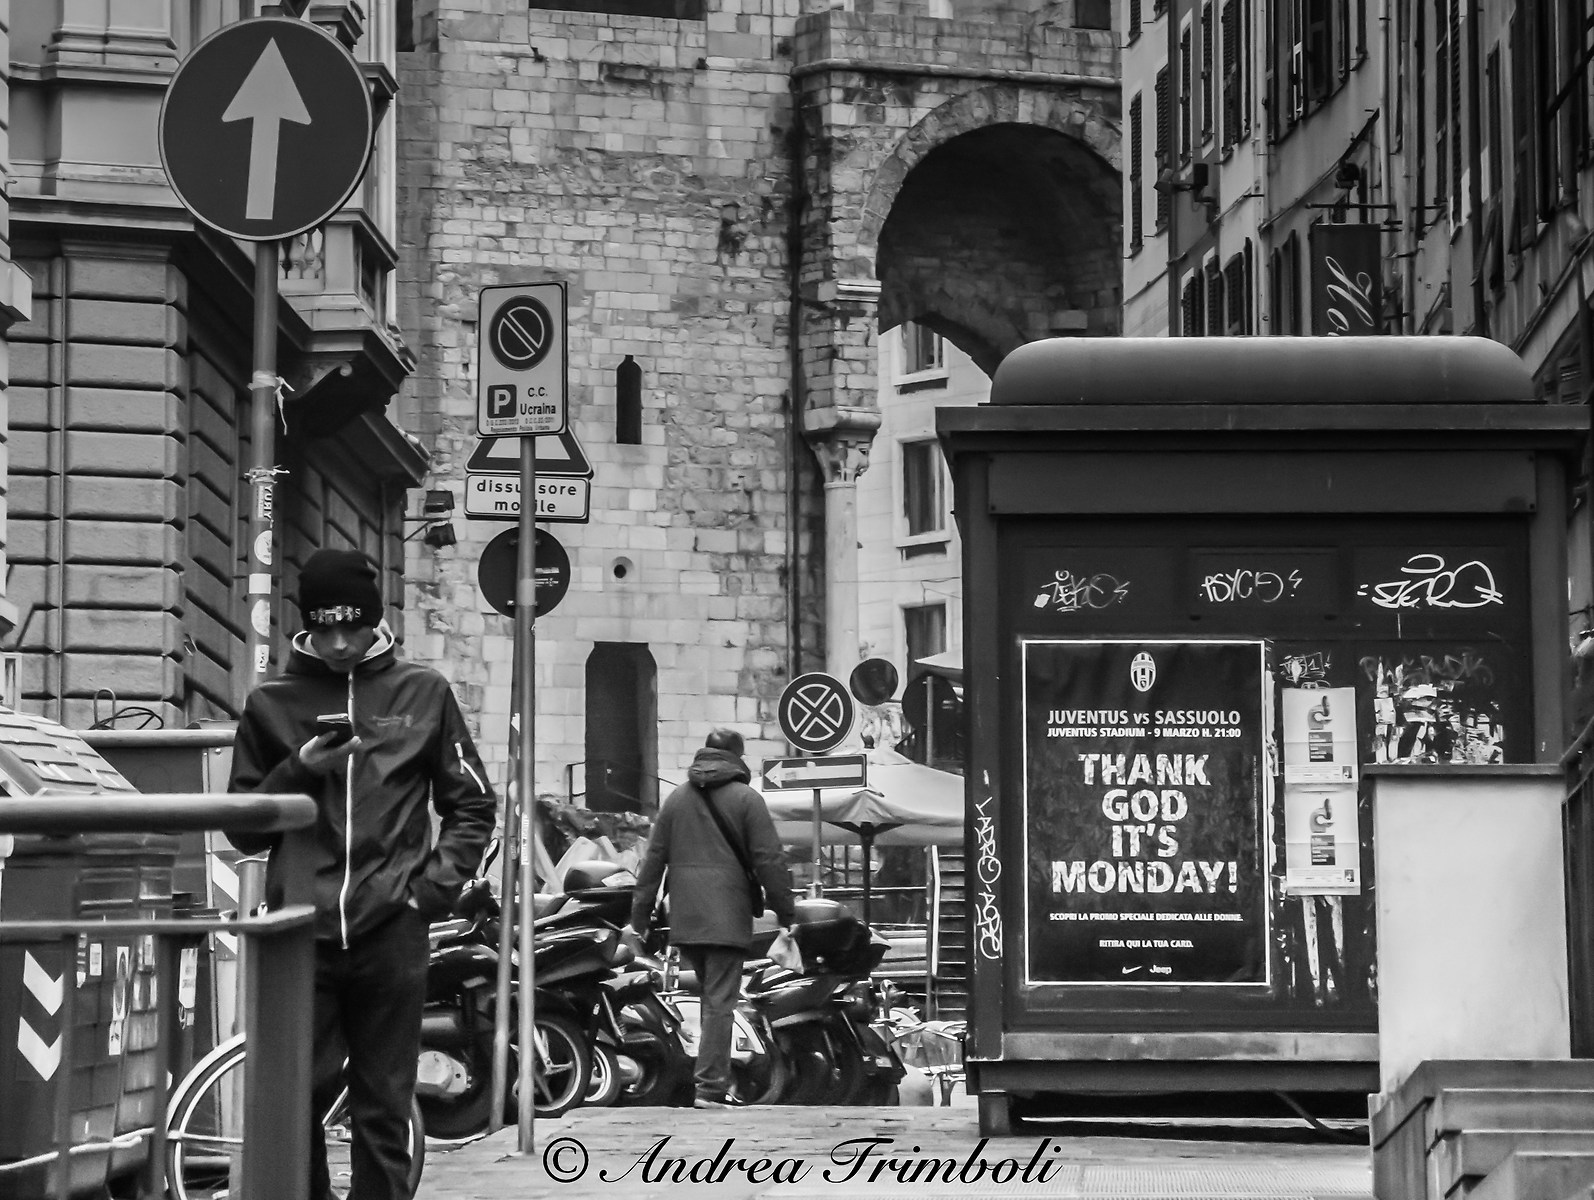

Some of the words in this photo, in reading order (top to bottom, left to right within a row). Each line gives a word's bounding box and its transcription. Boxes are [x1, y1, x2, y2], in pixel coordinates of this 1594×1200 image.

[493, 388, 511, 415] P
[519, 402, 557, 416] Ucraina
[476, 479, 577, 496] dissusore
[494, 499, 556, 513] moile
[1046, 710, 1129, 725] JUVENTUS
[1154, 710, 1241, 725] SASSUOLO
[1046, 727, 1098, 738] JUVENTUS
[1099, 727, 1146, 738] STADIUM
[1154, 727, 1161, 738] 9
[1162, 727, 1200, 738] MARZO
[1214, 727, 1242, 738] 21:00
[1077, 753, 1212, 786] THANK
[1101, 788, 1189, 822] GOD
[1111, 823, 1179, 858] IT'S
[1051, 860, 1238, 894] MONDAY!
[1049, 912, 1077, 922] SCOPRI
[1078, 912, 1089, 922] LA
[1089, 912, 1119, 922] PROMO
[1119, 912, 1155, 922] SPECIALE
[1155, 912, 1194, 922] DEDICATA
[1194, 912, 1213, 922] ALLE
[1099, 939, 1125, 949] RITIRA
[1125, 939, 1141, 950] QUI
[1141, 939, 1153, 949] LA
[1153, 939, 1170, 949] TUA
[1149, 964, 1173, 975] Jeep
